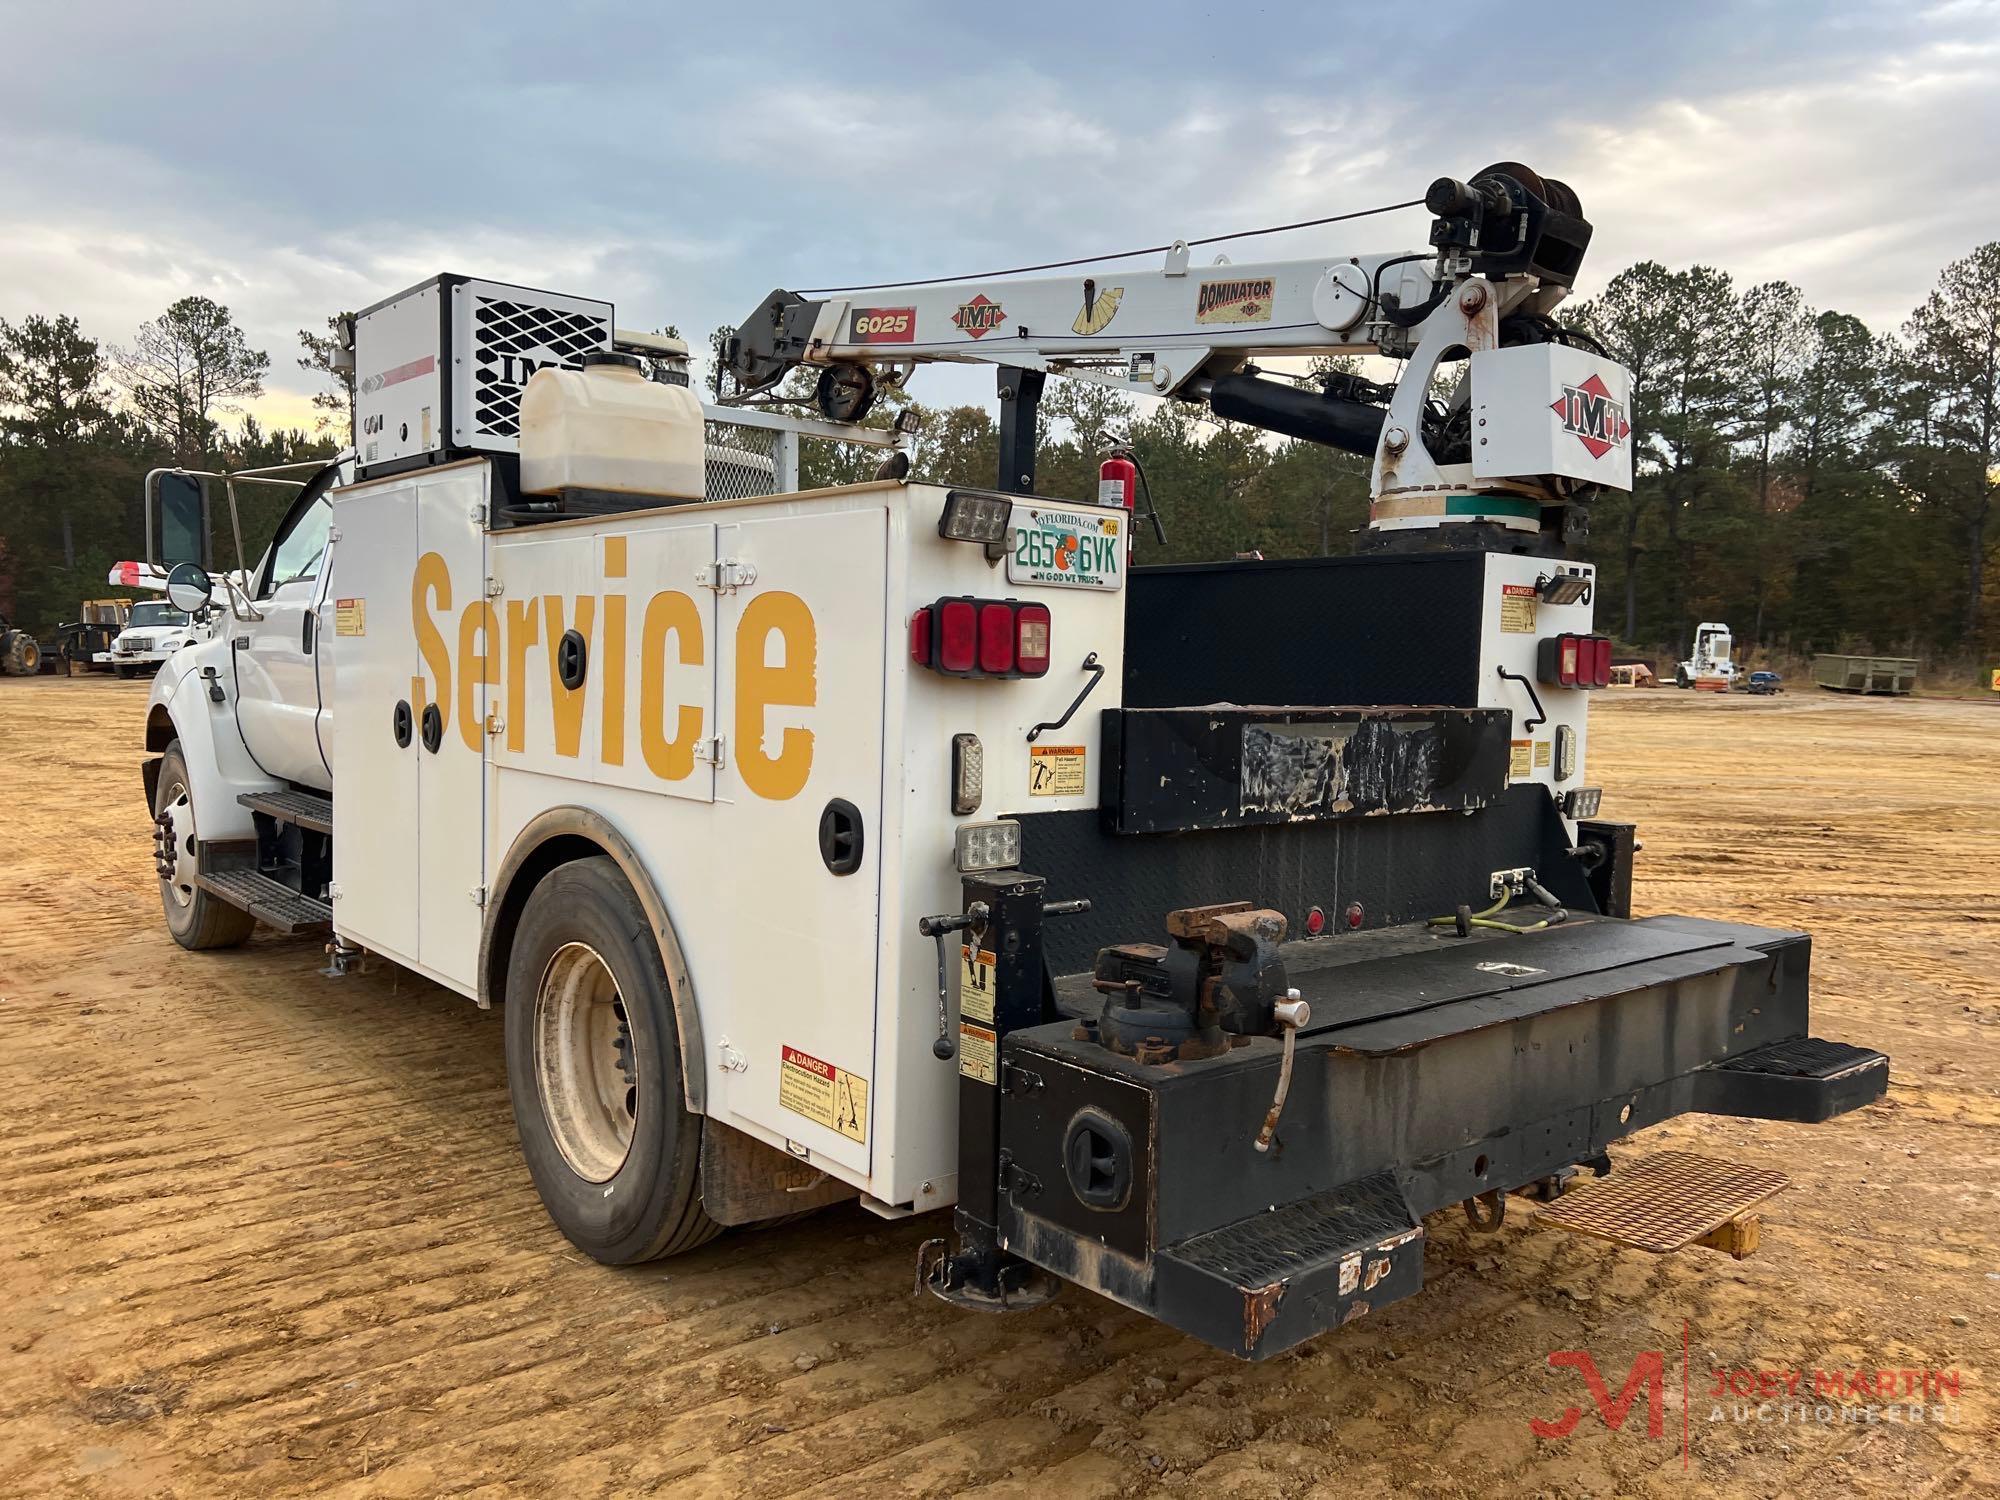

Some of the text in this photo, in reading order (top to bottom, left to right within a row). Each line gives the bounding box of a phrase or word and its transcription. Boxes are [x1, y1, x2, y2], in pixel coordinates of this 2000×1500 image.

[1198, 280, 1273, 315] DOMINATOR
[856, 315, 909, 334] 6025
[957, 303, 1001, 330] IMT
[1562, 384, 1624, 448] IMT
[1034, 513, 1099, 533] MYFLORIDA.COM
[1016, 528, 1117, 573] 265 6VK
[1036, 571, 1100, 584] IN GOD WE TRUST
[412, 536, 817, 800] Service
[796, 1053, 829, 1076] DANGER
